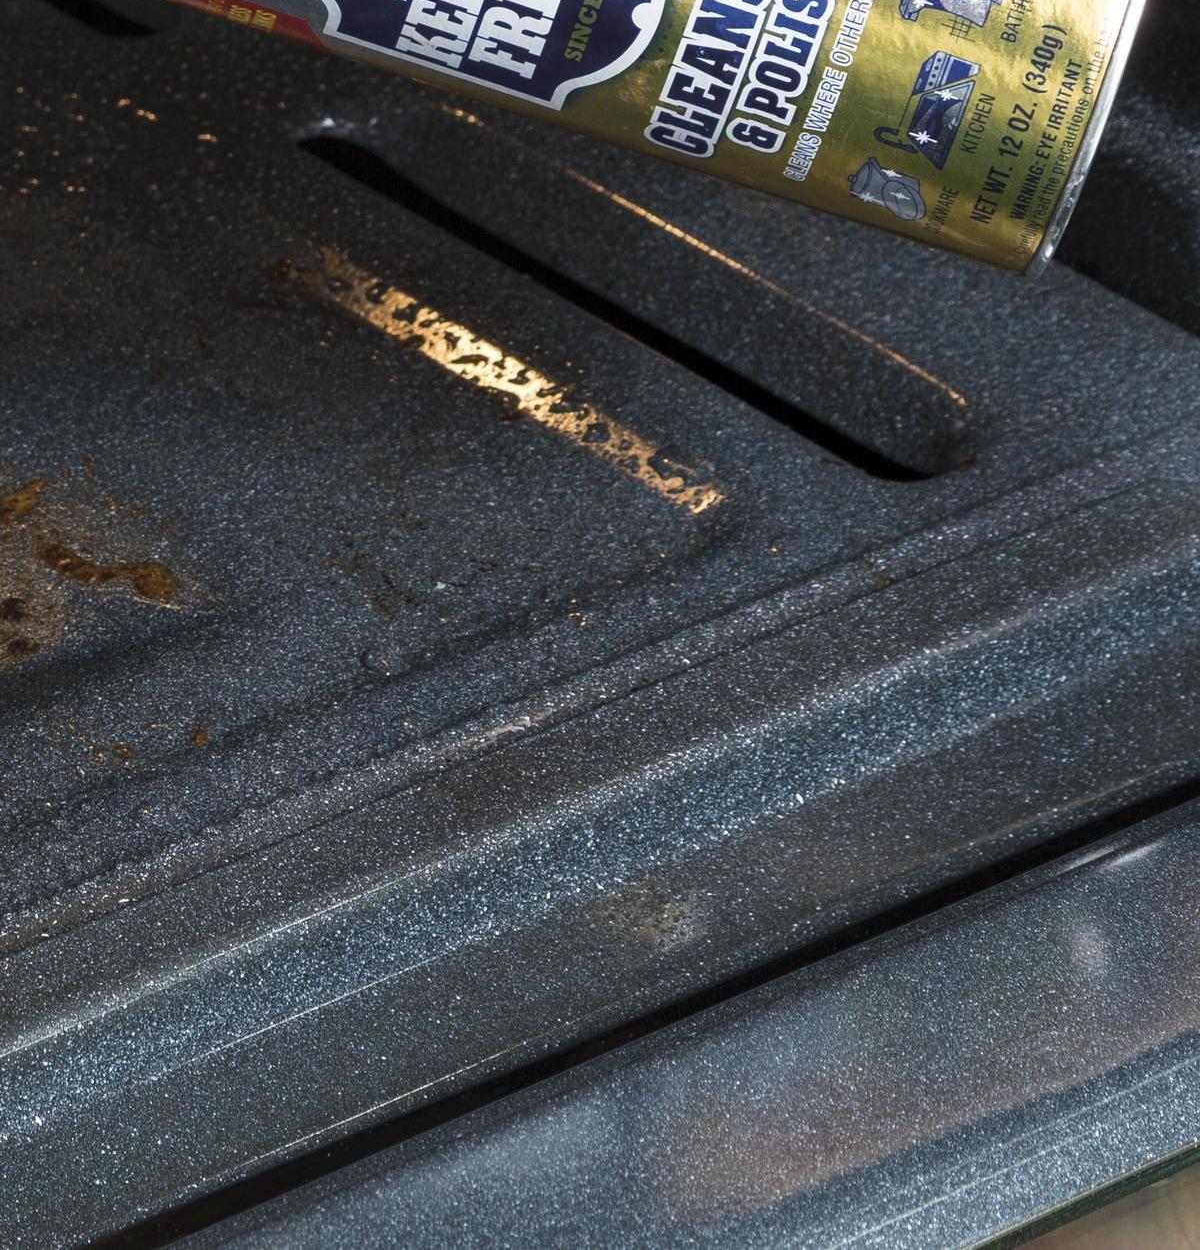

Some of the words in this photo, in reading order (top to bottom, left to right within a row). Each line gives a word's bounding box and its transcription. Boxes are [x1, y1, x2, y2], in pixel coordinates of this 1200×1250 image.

[1085, 48, 1107, 74] the
[1044, 57, 1084, 131] IRRITANT
[1078, 74, 1097, 96] on
[784, 132, 822, 182] CLEANS
[803, 67, 847, 132] WHERE
[958, 91, 997, 155] KITCHEN
[1005, 95, 1038, 135] OZ.
[730, 120, 781, 152] &
[996, 133, 1024, 161] 12
[1034, 130, 1058, 161] EYE
[1048, 95, 1092, 177] precautions
[981, 159, 1013, 197] WT.
[1009, 157, 1047, 223] WARNING:
[1039, 174, 1061, 197] the
[923, 185, 960, 237] COOKWARE
[968, 193, 999, 226] NET
[1031, 194, 1053, 221] read
